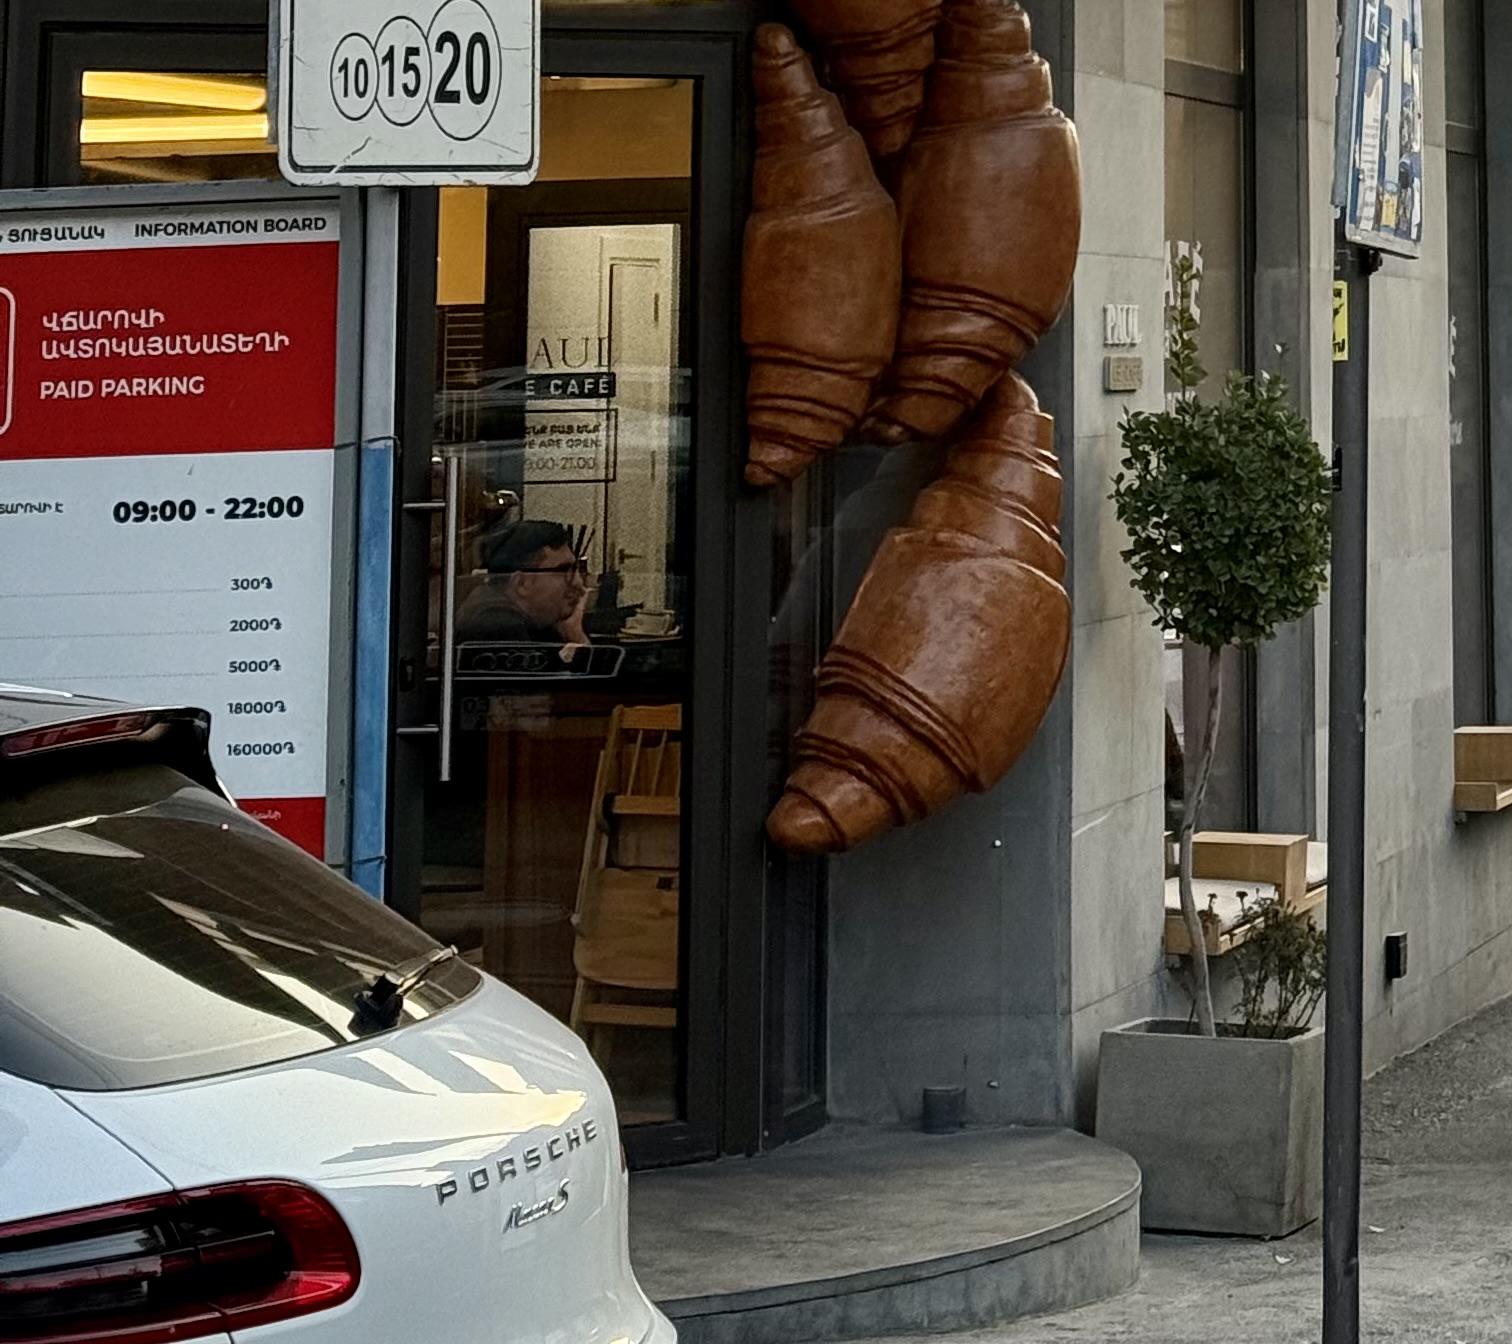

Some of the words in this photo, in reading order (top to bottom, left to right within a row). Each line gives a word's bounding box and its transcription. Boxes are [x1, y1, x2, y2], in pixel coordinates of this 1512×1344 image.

[337, 57, 369, 99] 10
[381, 44, 421, 98] 15
[433, 30, 491, 105] 20
[135, 220, 259, 238] INFORMATION
[263, 217, 327, 233] BOARD
[39, 380, 95, 400] PAID
[100, 376, 206, 398] PARKING
[112, 499, 197, 525] 09:00
[222, 495, 305, 521] 22:00
[436, 1116, 598, 1206] PORSCHE
